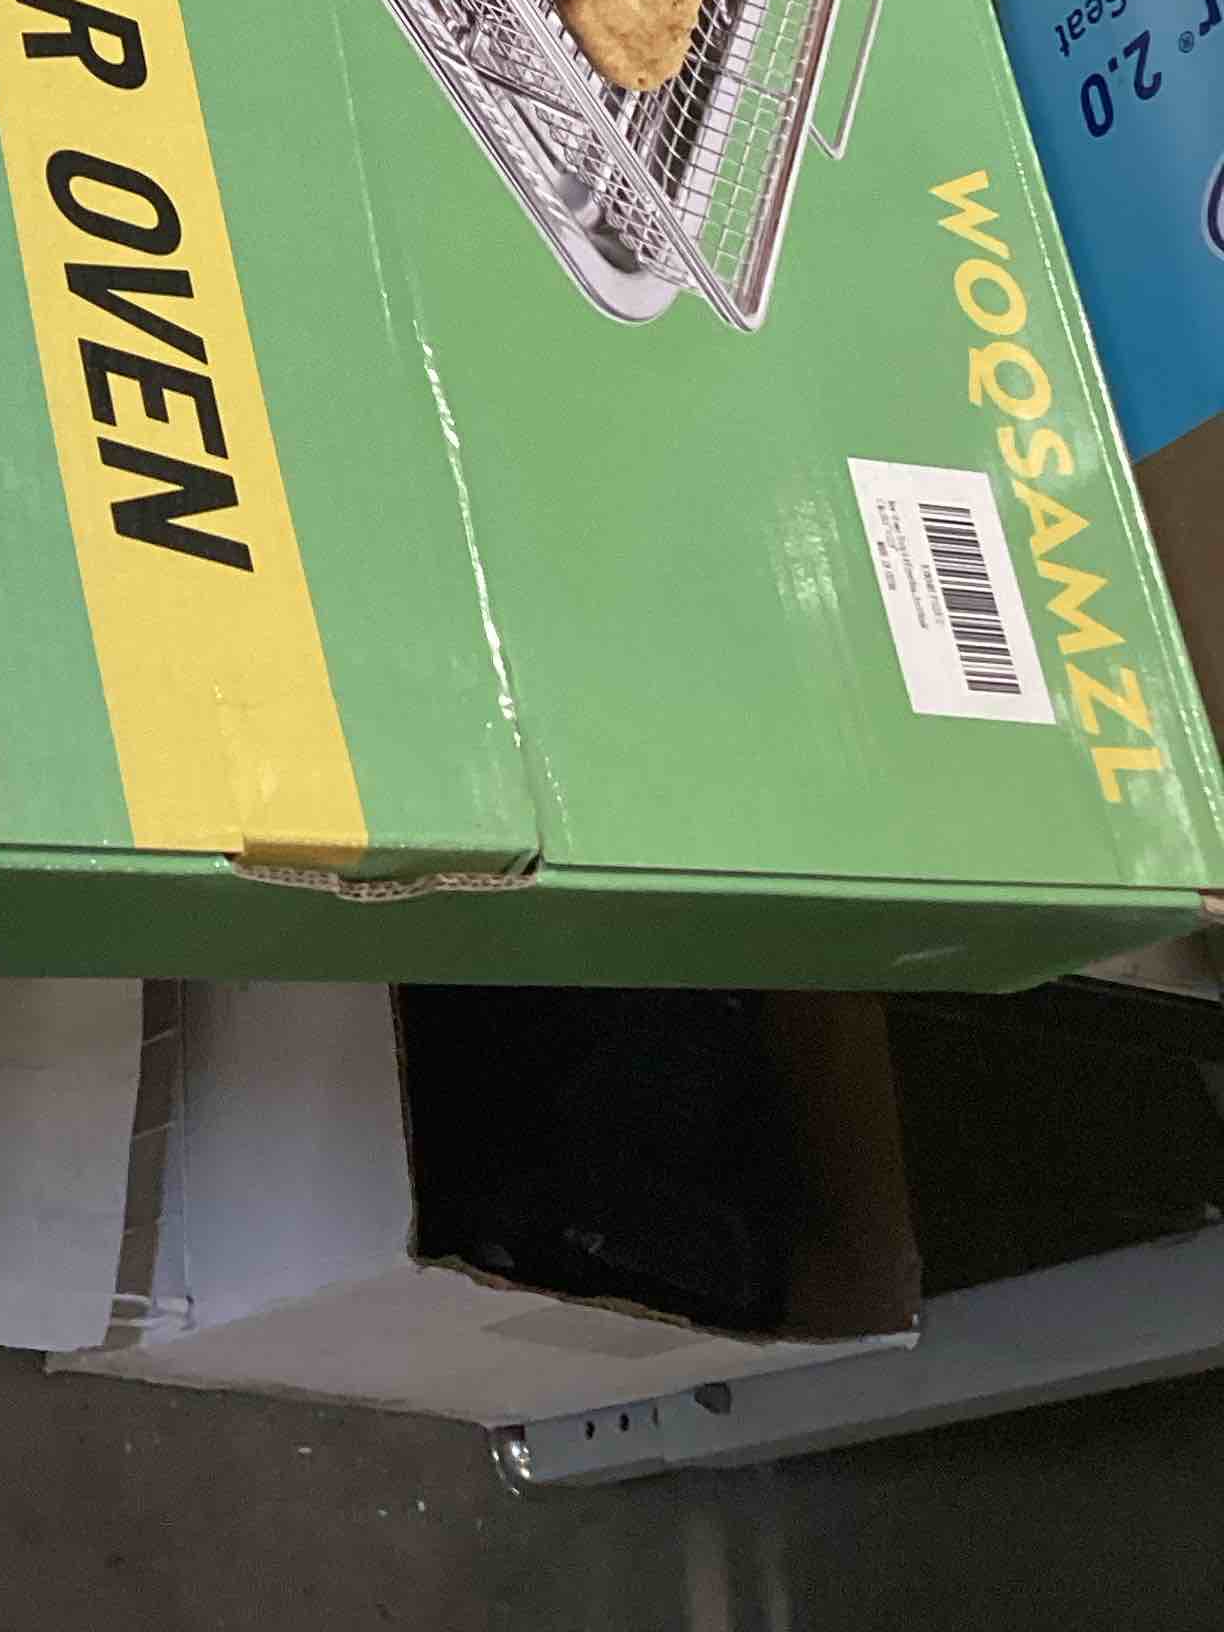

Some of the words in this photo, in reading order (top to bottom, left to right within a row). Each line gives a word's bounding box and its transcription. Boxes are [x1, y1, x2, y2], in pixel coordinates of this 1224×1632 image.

[1079, 29, 1163, 139] 2.0
[45, 149, 254, 575] OVEN
[928, 170, 1163, 804] WOQSAMZL
